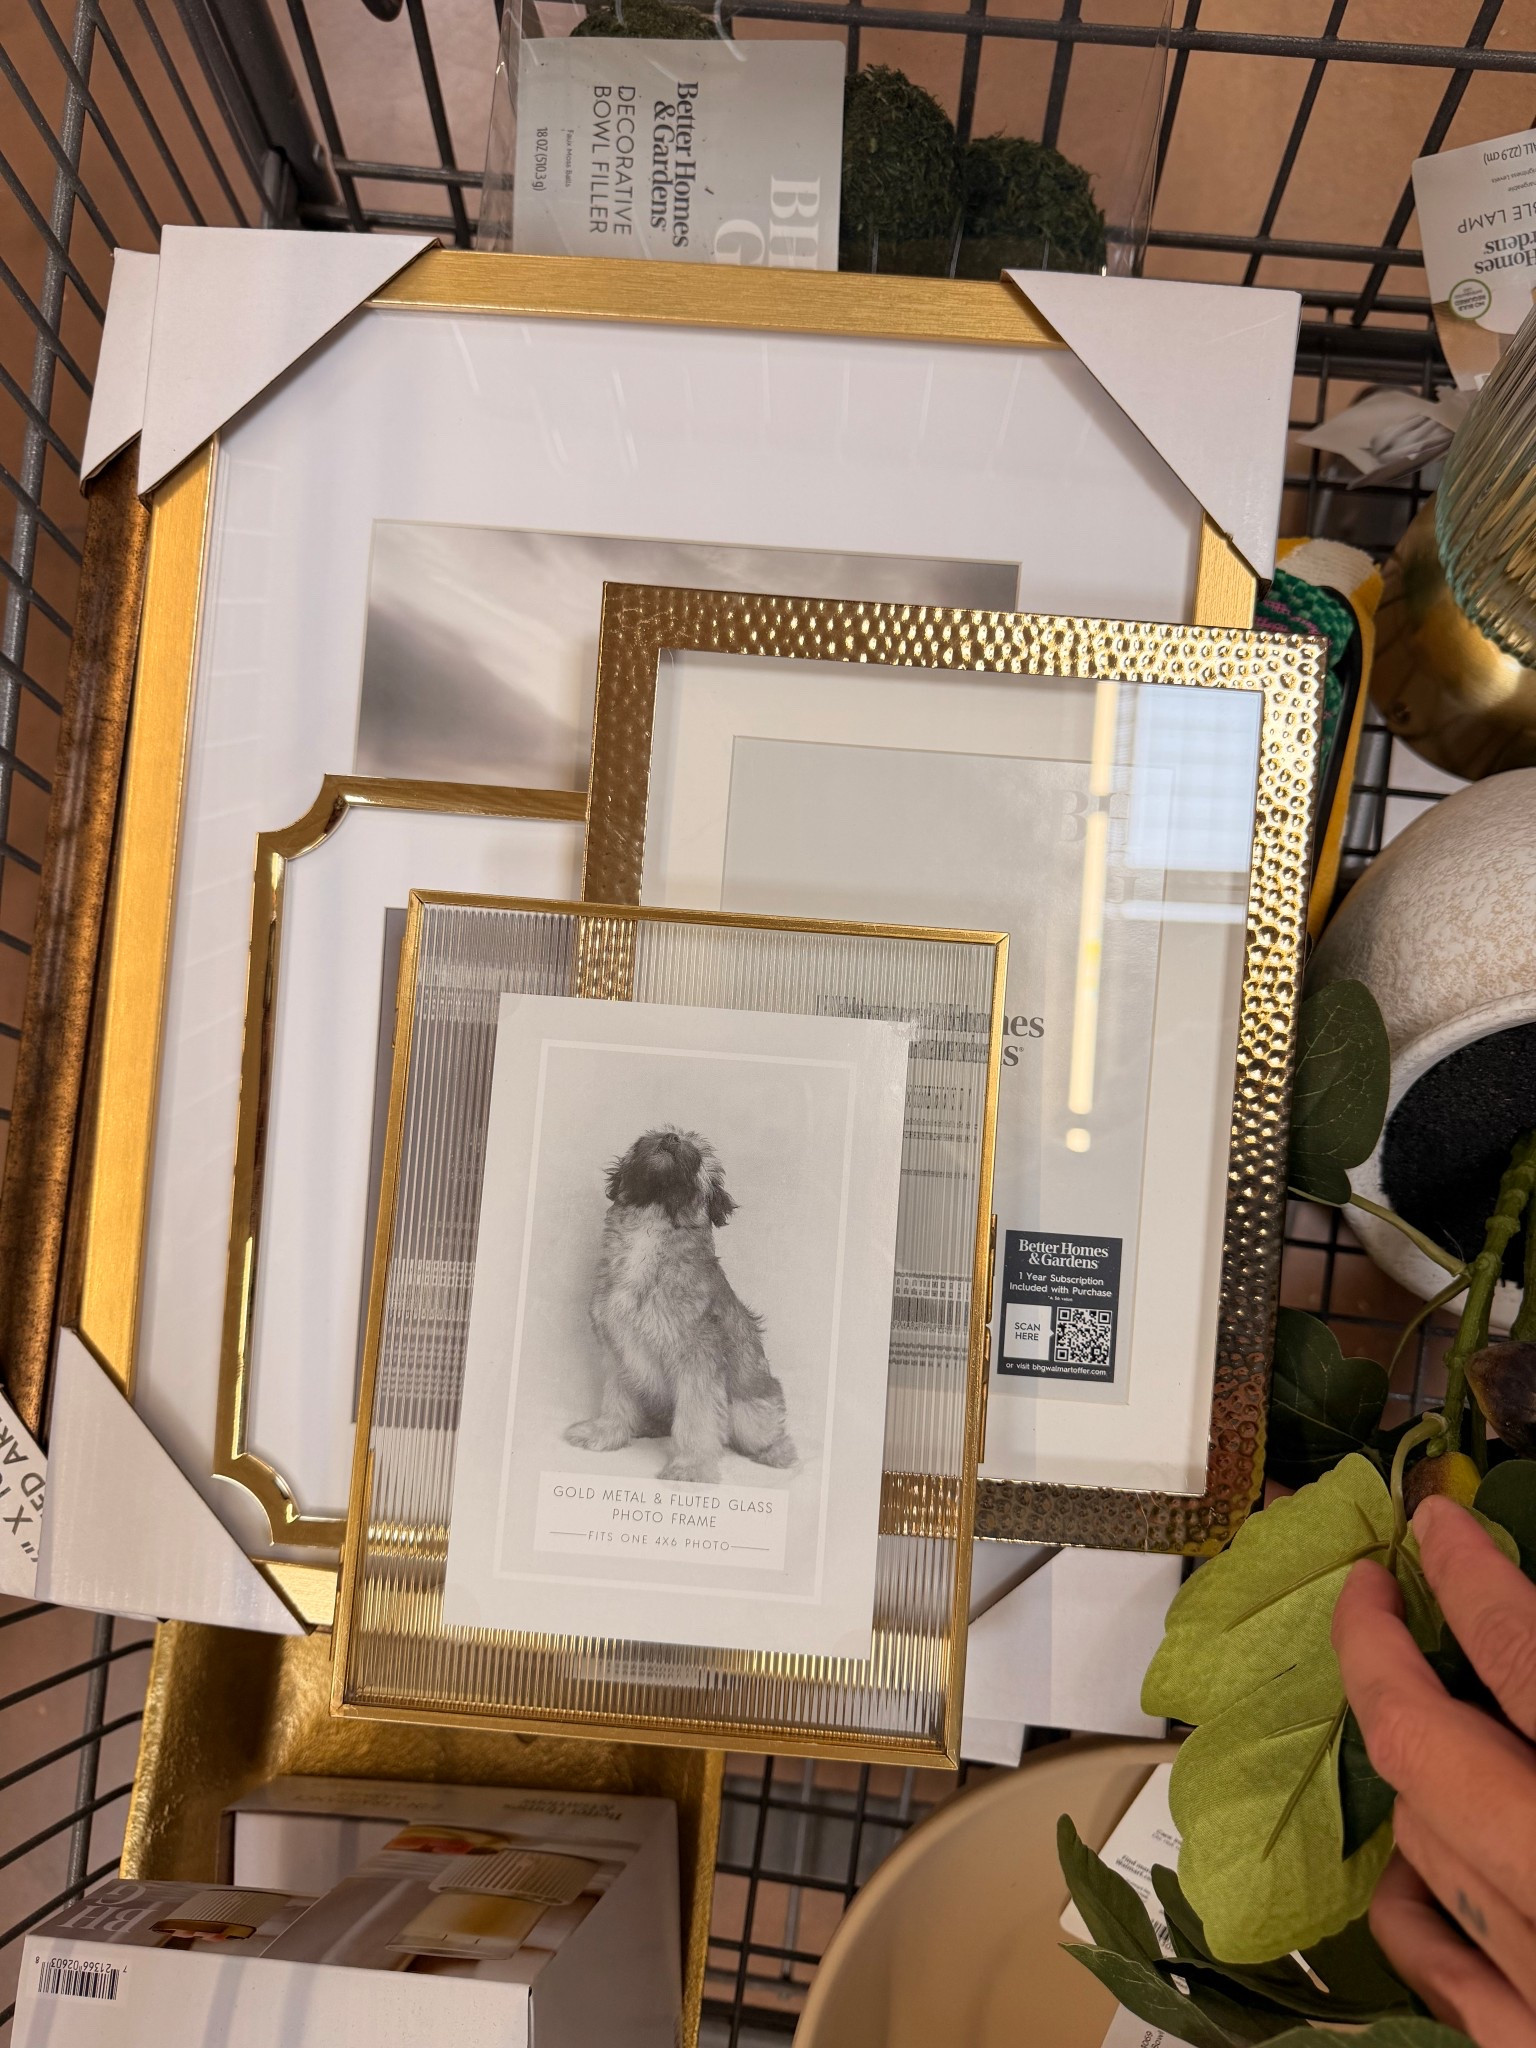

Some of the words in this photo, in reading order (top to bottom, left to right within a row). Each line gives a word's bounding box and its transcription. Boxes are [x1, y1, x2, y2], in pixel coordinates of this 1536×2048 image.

[591, 86, 612, 154] BOWL
[675, 81, 699, 157] Better
[536, 127, 548, 138] 18
[566, 129, 575, 148] Faux
[536, 139, 548, 152] OZ
[1501, 144, 1522, 161] (22.9
[613, 86, 636, 235] DECORATIVE
[1483, 151, 1500, 166] cm)
[589, 161, 610, 233] FILLER
[672, 160, 697, 248] Homes
[1457, 209, 1507, 234] LAMP
[1018, 1239, 1059, 1254] Better
[1061, 1242, 1109, 1257] Homes
[1018, 1271, 1023, 1280] 1
[1026, 1272, 1047, 1282] Year
[1050, 1274, 1104, 1286] Subscription
[1009, 1282, 1048, 1293] Included
[1051, 1286, 1069, 1294] with
[1072, 1286, 1112, 1297] Purchase
[1014, 1322, 1041, 1331] SCAN
[1015, 1331, 1039, 1341] HERE
[1016, 1362, 1030, 1370] visit
[1032, 1363, 1107, 1376] bhgwalmartoffer.com
[553, 1485, 595, 1500] GOLD
[602, 1489, 647, 1504] METAL
[653, 1492, 663, 1505] &
[670, 1493, 720, 1509] FLUTED
[728, 1499, 773, 1514] GLASS
[3, 1504, 33, 1536] X
[612, 1508, 663, 1523] PHOTO
[671, 1512, 717, 1528] FRAME
[588, 1530, 613, 1542] FITS
[620, 1533, 648, 1545] ONE
[655, 1535, 678, 1547] 4X6
[685, 1538, 730, 1551] PHOTO
[95, 1883, 147, 1905] G
[57, 1905, 160, 1933] BH
[35, 1956, 40, 1964] 8
[50, 1957, 79, 1970] 02603
[83, 1961, 112, 1974] 21366
[122, 1965, 128, 1973] 7
